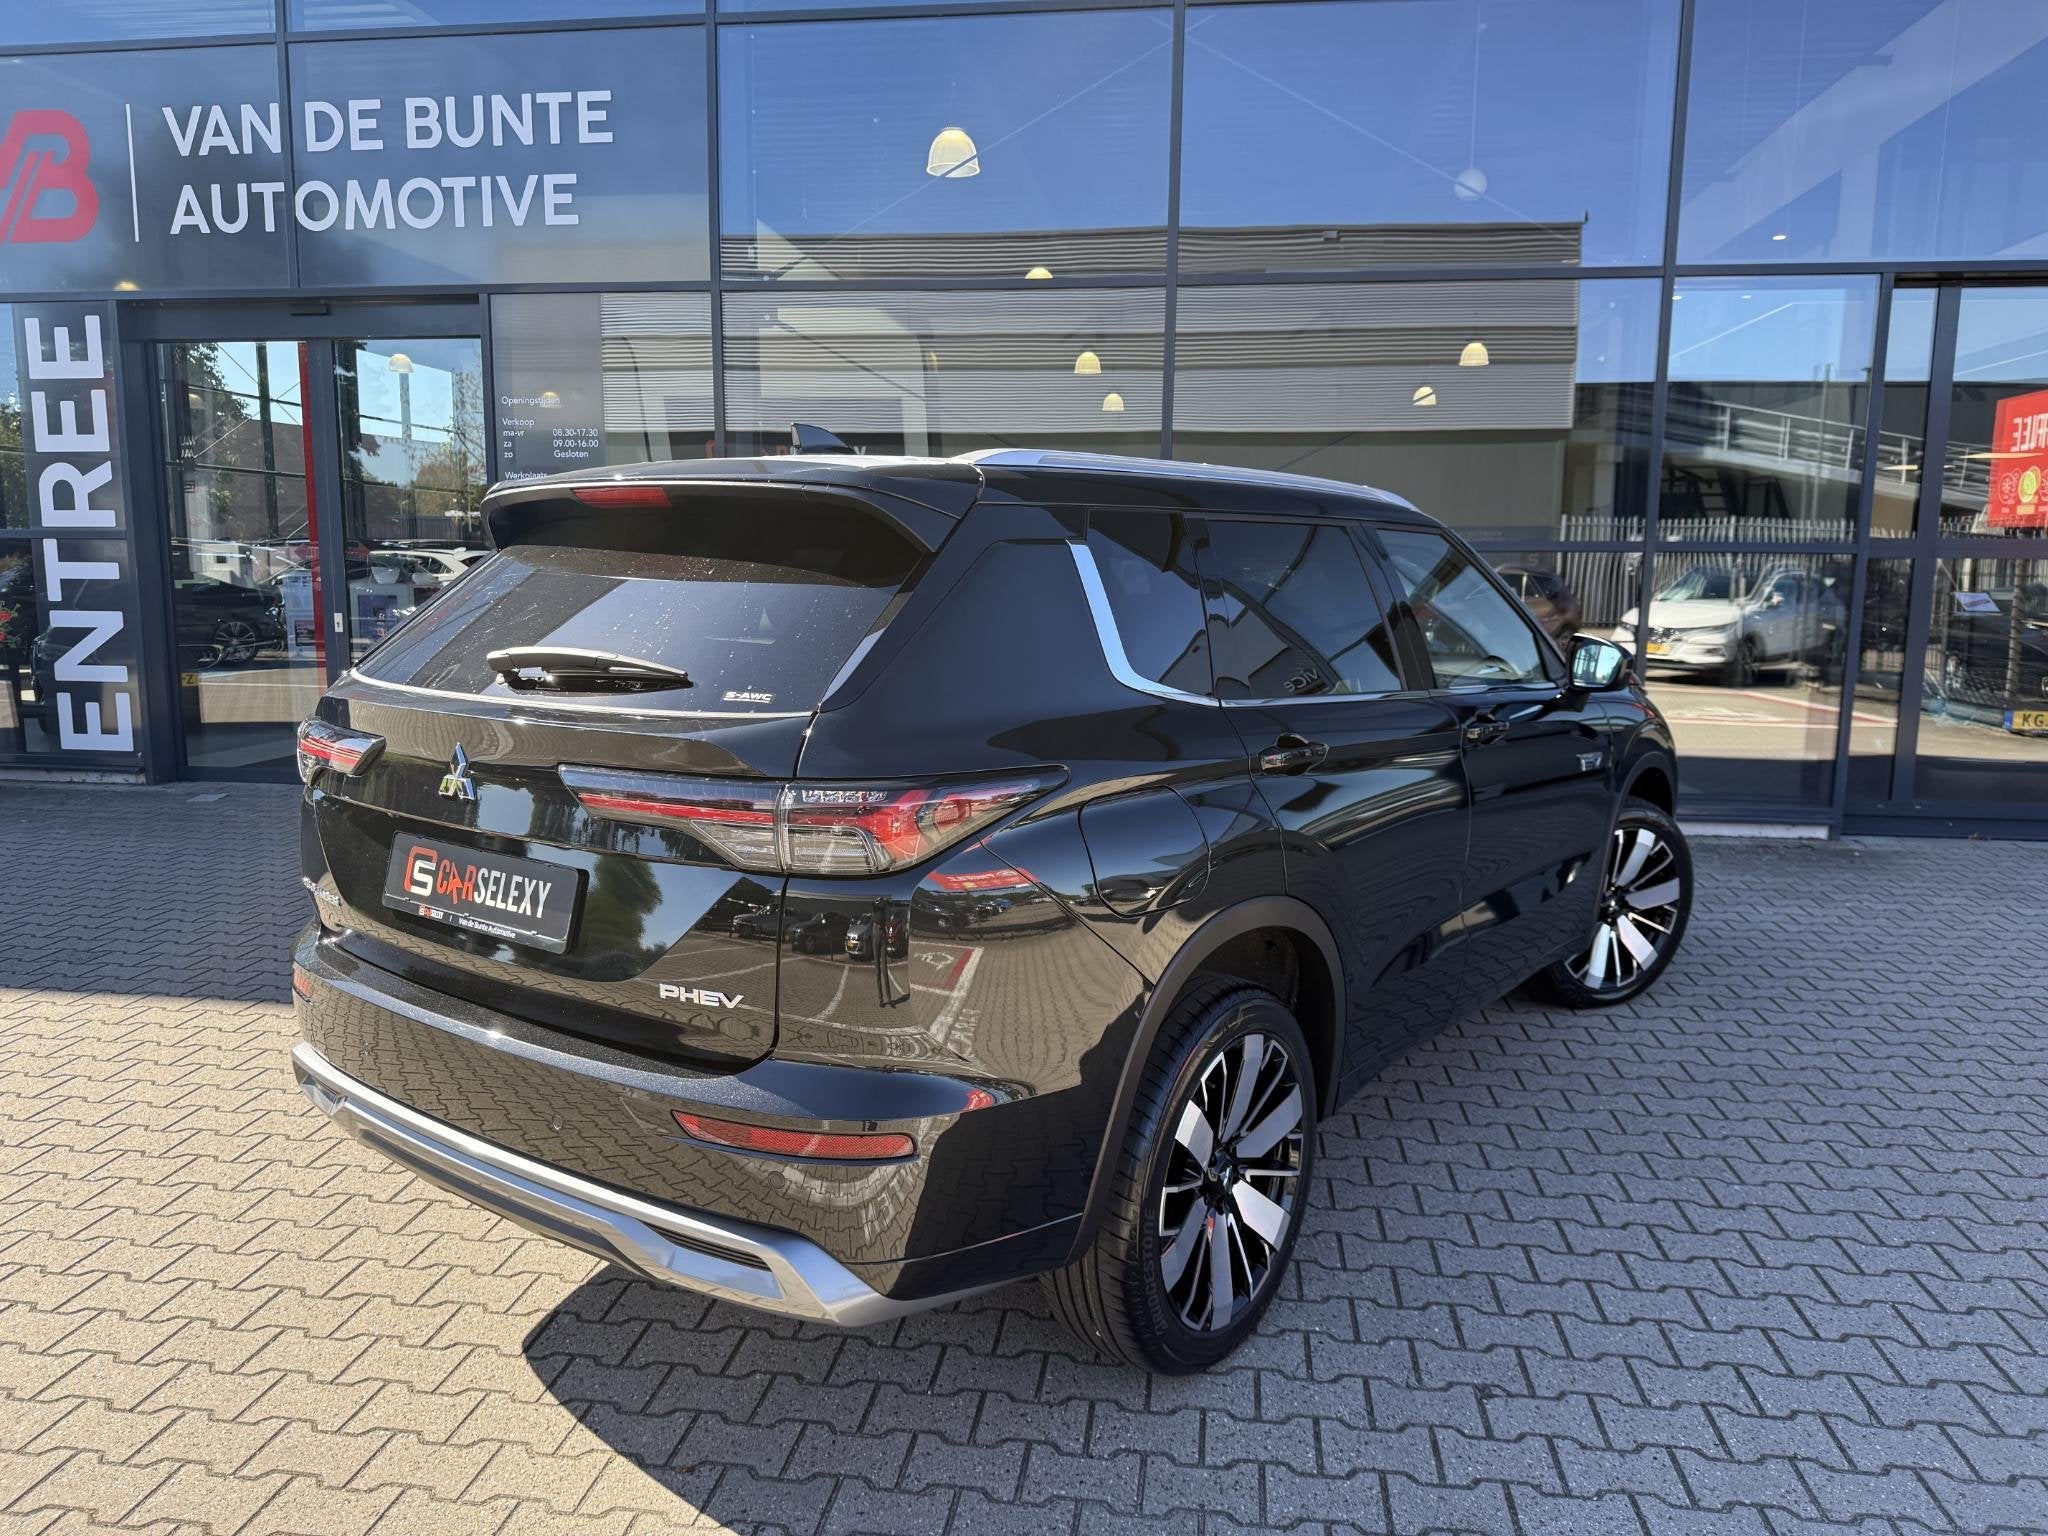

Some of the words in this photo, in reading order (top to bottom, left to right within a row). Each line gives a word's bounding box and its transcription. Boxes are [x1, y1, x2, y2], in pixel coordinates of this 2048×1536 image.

[161, 102, 282, 157] VAN
[304, 97, 384, 154] DE
[405, 89, 614, 150] BUNTE
[169, 172, 580, 235] AUTOMOTIVE
[501, 396, 560, 407] Openingstijden
[502, 418, 535, 428] Verkoop
[552, 428, 599, 437] 08.30-17.30
[553, 440, 599, 448] 09.00-16.00
[553, 450, 589, 458] Gesloten
[24, 314, 134, 752] ENTREE
[724, 691, 773, 702] S-AWC
[436, 858, 553, 920] CARSELEXY
[659, 983, 745, 1009] PHEV
